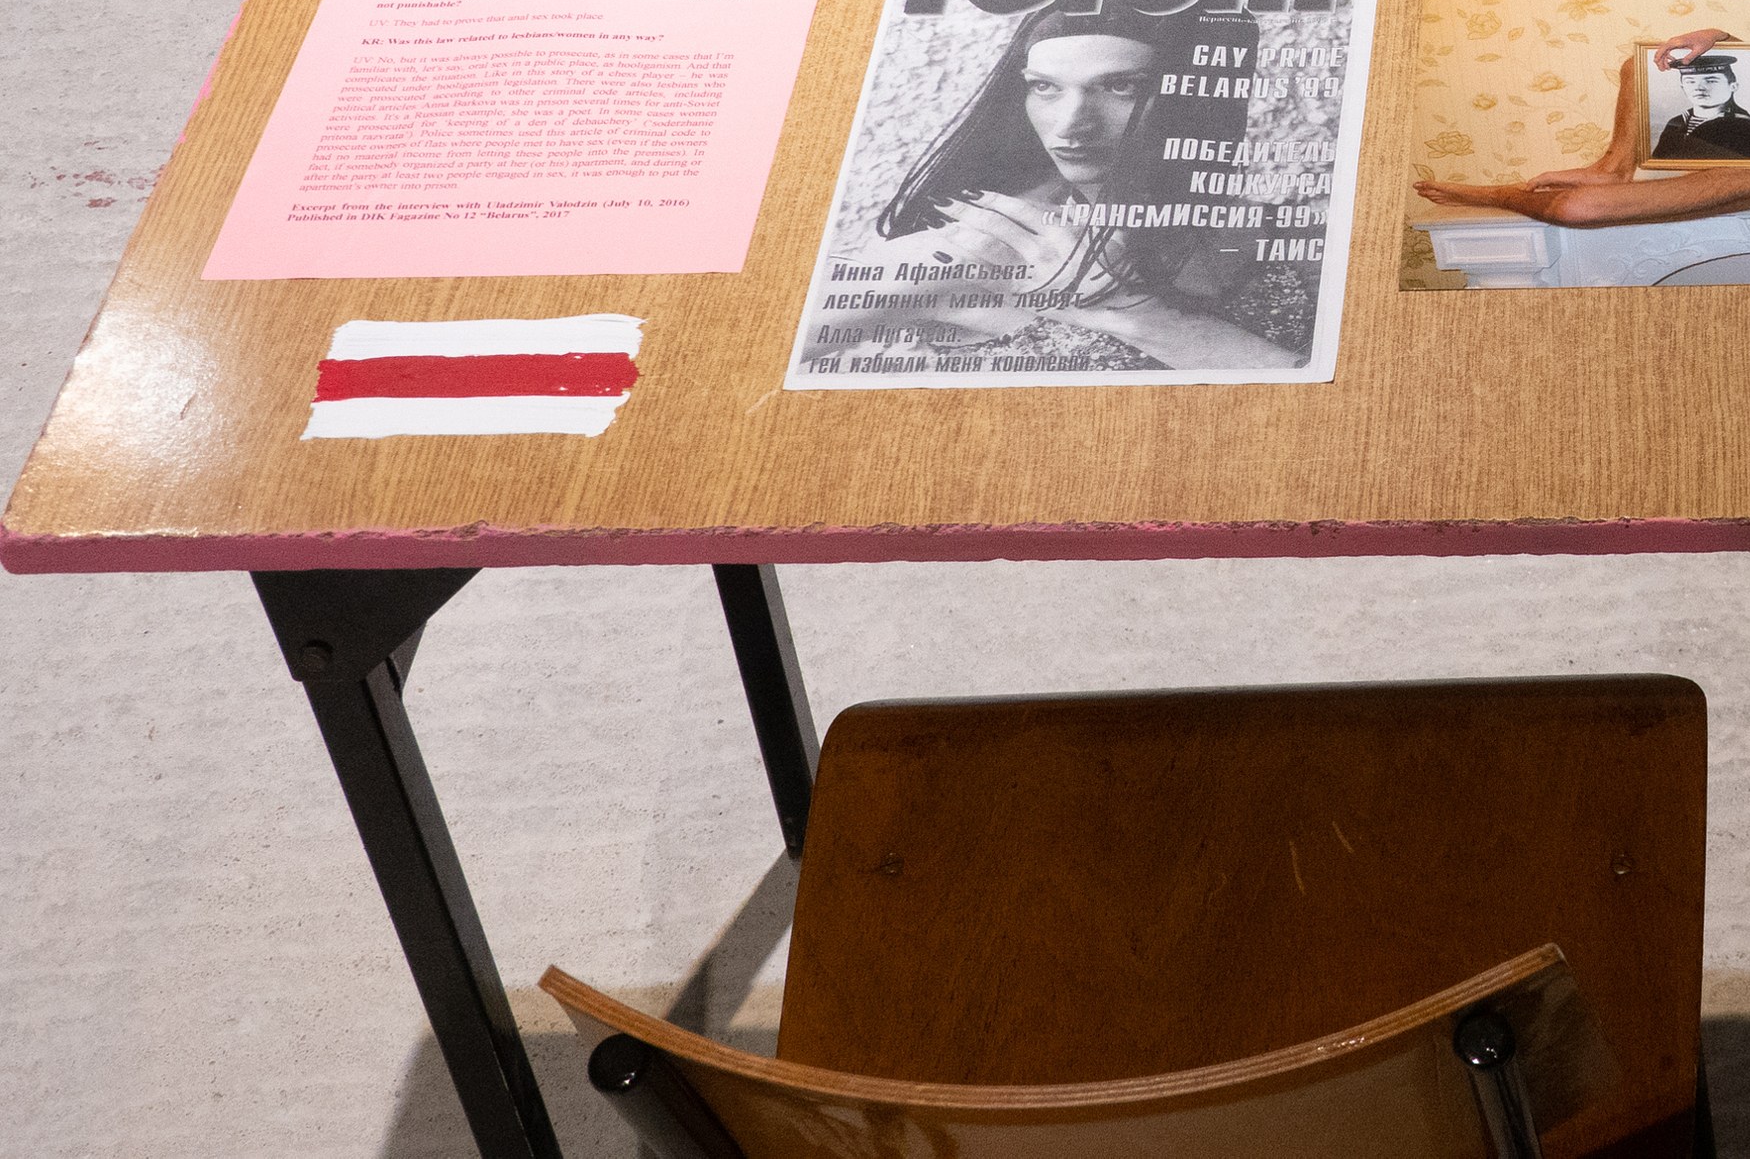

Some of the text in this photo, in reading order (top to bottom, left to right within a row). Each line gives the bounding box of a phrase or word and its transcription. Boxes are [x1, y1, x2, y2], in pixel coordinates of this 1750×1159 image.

[375, 0, 461, 9] not punishable?
[453, 17, 483, 25] prove
[507, 13, 529, 21] anal
[531, 13, 547, 21] sex
[387, 37, 410, 45] Was
[435, 36, 453, 44] law
[457, 33, 495, 42] related
[497, 33, 508, 41] to
[635, 34, 664, 42] way?
[1193, 44, 1344, 69] GAY PRIDE
[1163, 138, 1335, 167] ПОБЕДИТЕЛЬ
[1190, 171, 1332, 195] КОНКУРСА
[291, 203, 336, 212] Excerpt
[341, 202, 369, 210] from
[602, 199, 630, 208] (July
[658, 198, 690, 206] 2016)
[286, 213, 343, 221] Published
[360, 212, 384, 220] DIK
[389, 212, 440, 221] Fagazine
[444, 211, 460, 219] No
[463, 211, 476, 219] 12
[542, 210, 570, 218] 2017
[1042, 204, 1329, 229] «ТРАНСМИССИЯ-99»
[1255, 239, 1324, 262] ТАИС
[831, 263, 1035, 285] Инна Афанасьева:
[822, 290, 1083, 310] лесбиянки меня любят
[816, 325, 862, 344] Алла
[850, 354, 926, 374] избрали
[935, 355, 984, 373] меня
